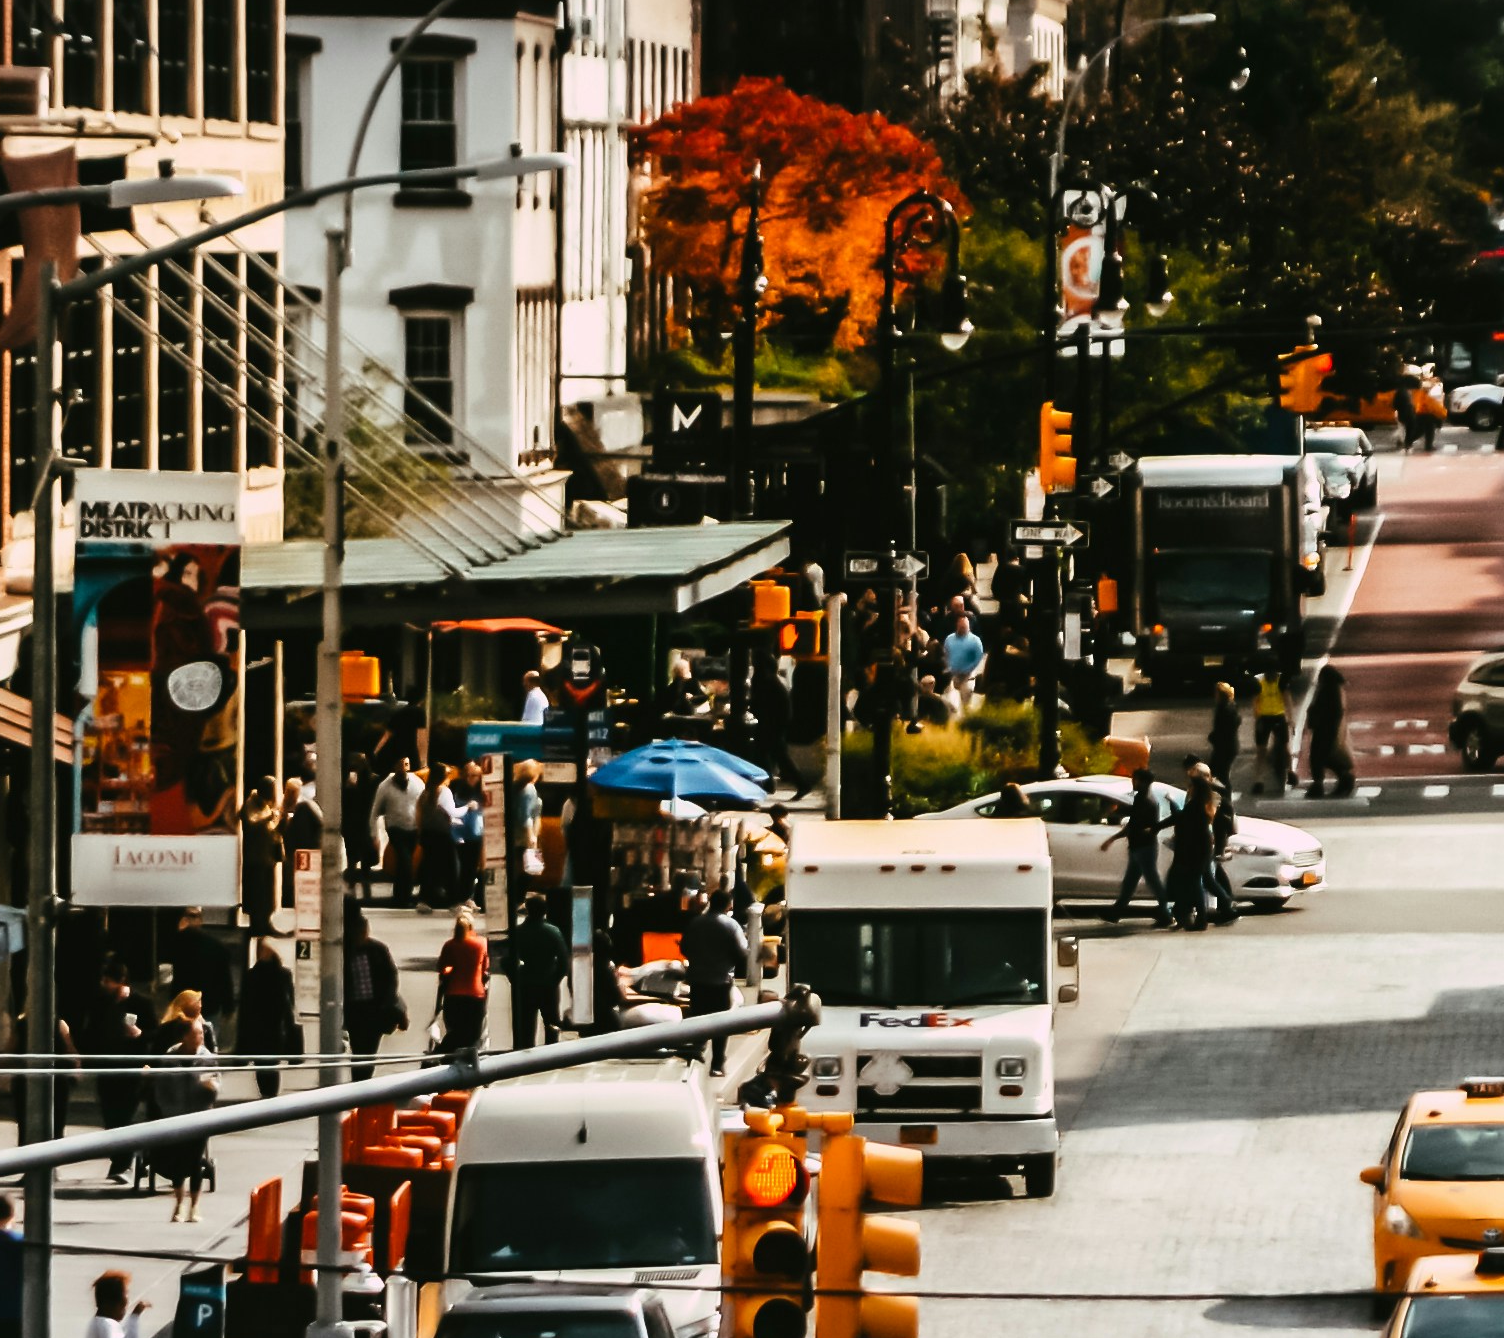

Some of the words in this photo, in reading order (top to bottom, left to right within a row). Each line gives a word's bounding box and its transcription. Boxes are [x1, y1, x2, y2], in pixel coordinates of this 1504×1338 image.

[80, 501, 236, 522] MEATPACKING
[859, 1013, 975, 1028] FedEx
[197, 1303, 213, 1328] P
